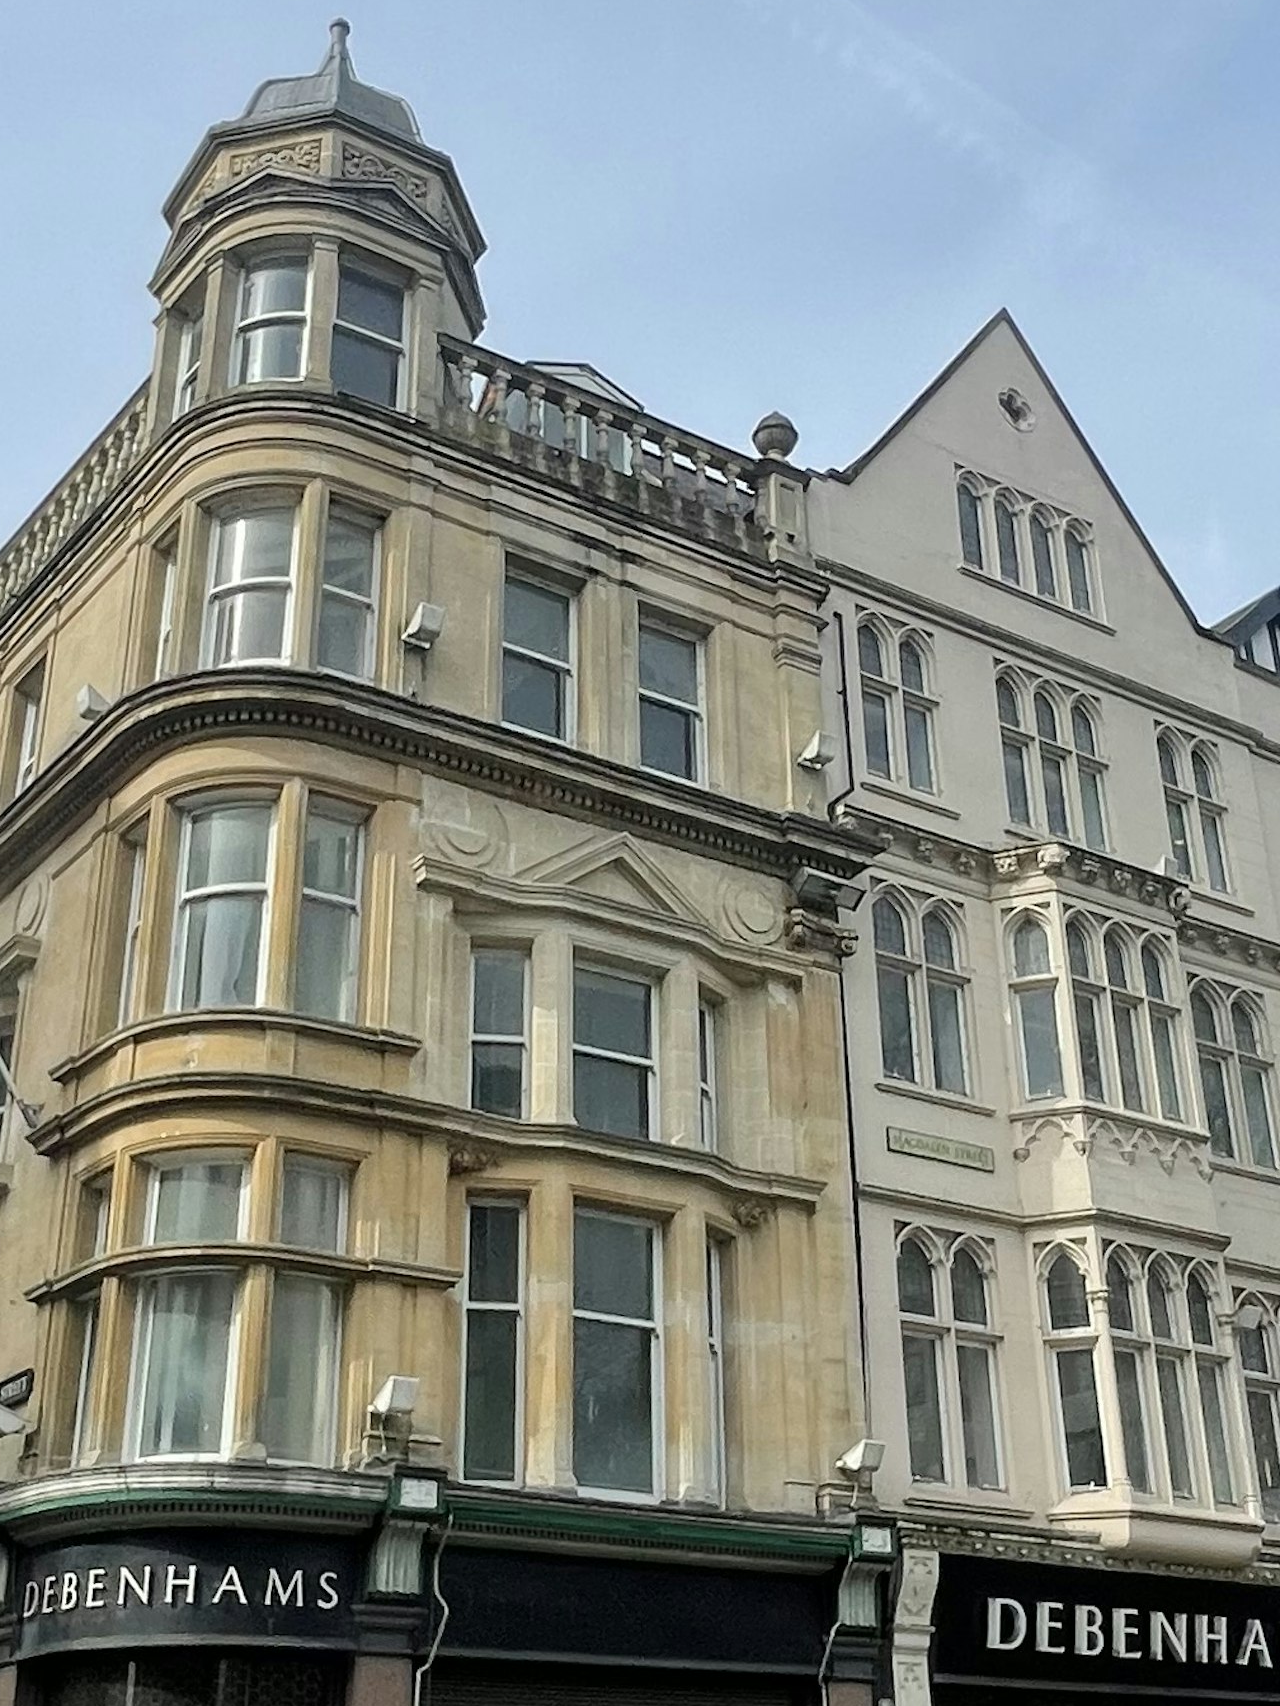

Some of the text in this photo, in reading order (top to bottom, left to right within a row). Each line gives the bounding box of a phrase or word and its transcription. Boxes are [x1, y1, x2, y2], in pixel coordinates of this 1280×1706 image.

[892, 1133, 990, 1167] MAGDALEN STREET
[23, 1564, 339, 1618] DEBENHAMS
